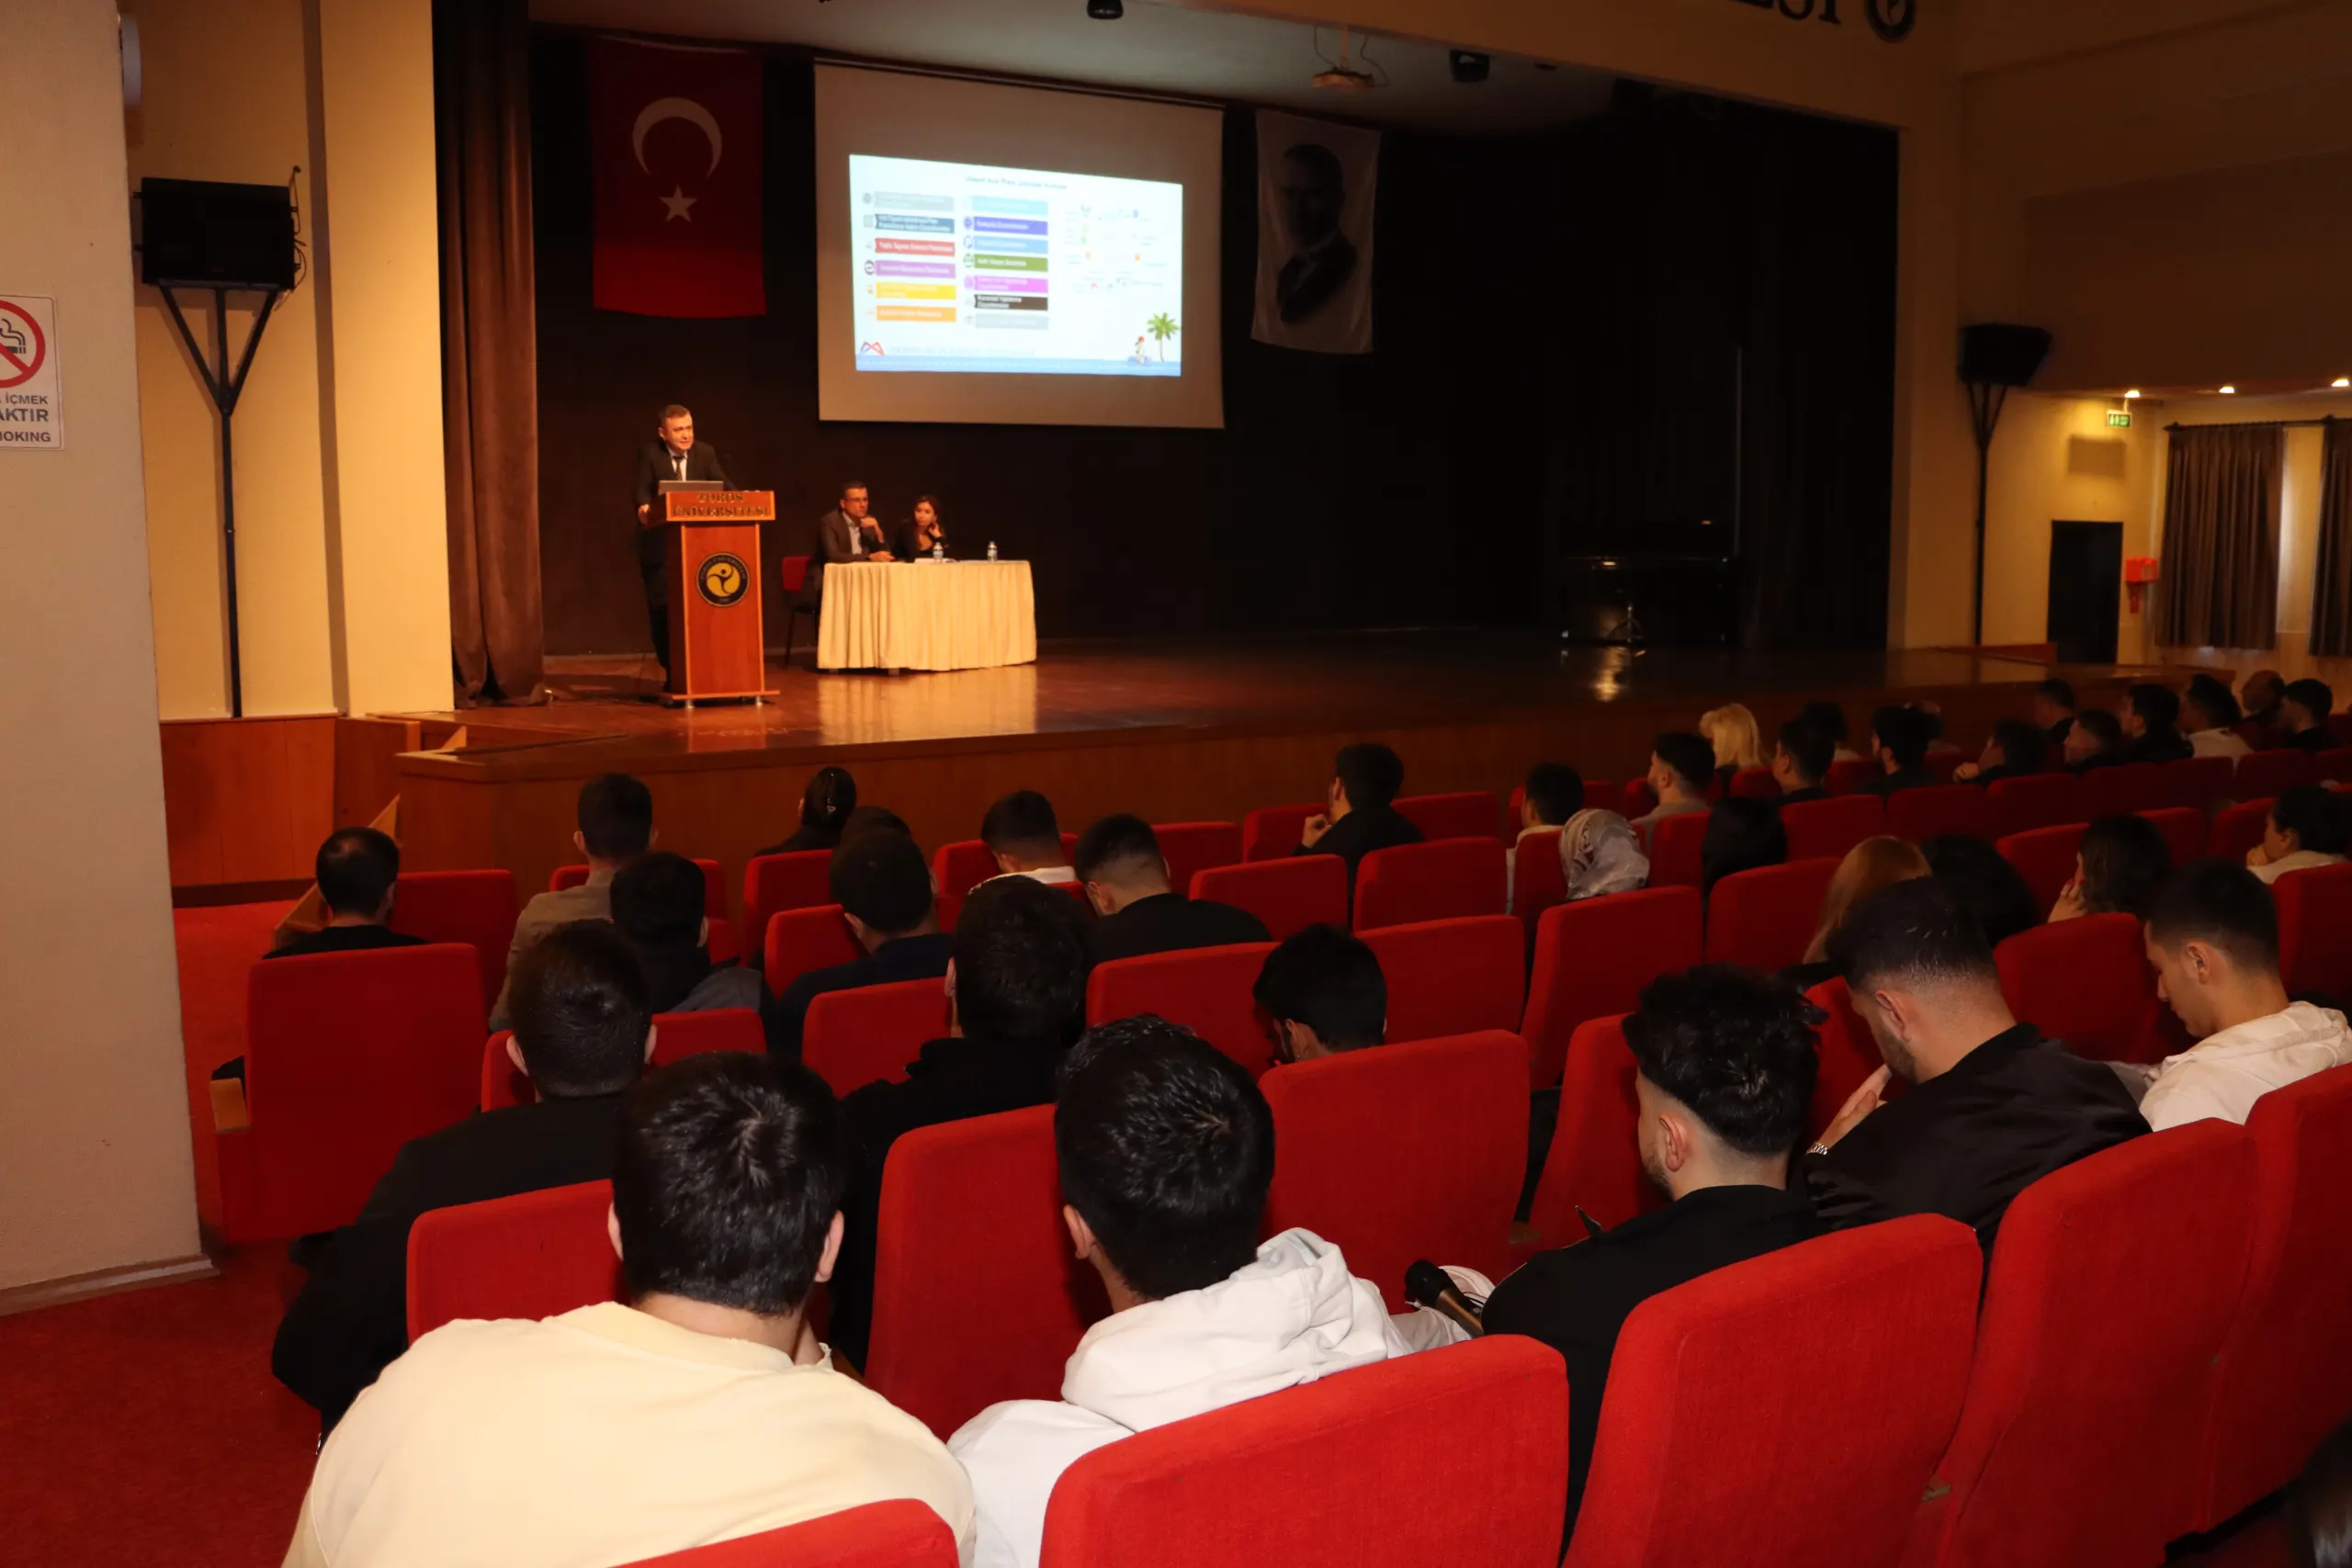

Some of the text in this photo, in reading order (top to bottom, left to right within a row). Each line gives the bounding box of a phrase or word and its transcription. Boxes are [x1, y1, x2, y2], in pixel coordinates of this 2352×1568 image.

[6, 391, 49, 406] İÇMEK
[0, 431, 51, 442] OKING
[697, 492, 744, 503] TOROS
